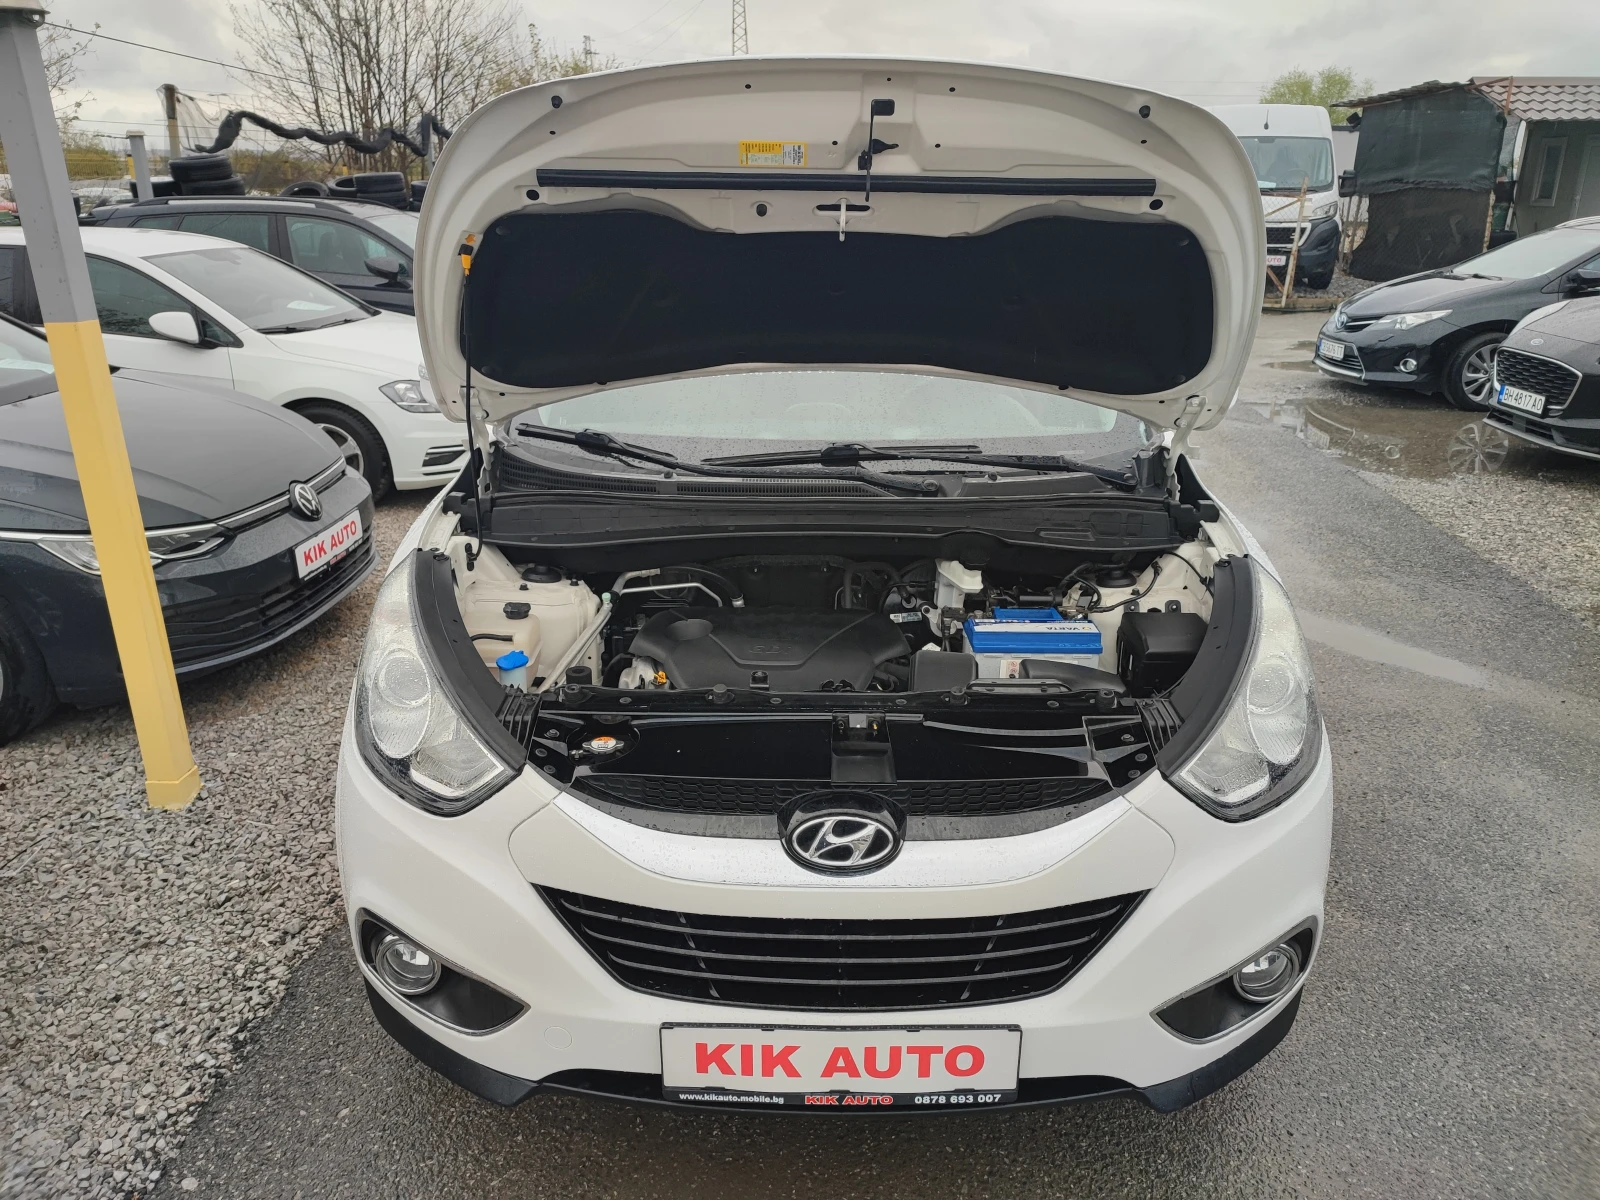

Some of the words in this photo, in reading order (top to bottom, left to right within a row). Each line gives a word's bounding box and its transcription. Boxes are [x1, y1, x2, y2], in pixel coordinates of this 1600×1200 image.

[1267, 256, 1282, 264] UTO
[303, 539, 327, 567] KIK
[330, 520, 357, 551] AUTO
[695, 1042, 802, 1078] KIK
[820, 1045, 985, 1079] AUTO
[679, 1093, 784, 1104] www.kikauto.mobile.bg
[804, 1095, 839, 1105] KIK
[843, 1095, 894, 1105] AUTO
[914, 1095, 946, 1104] 0878
[950, 1094, 974, 1104] 693
[977, 1093, 1002, 1103] 007
